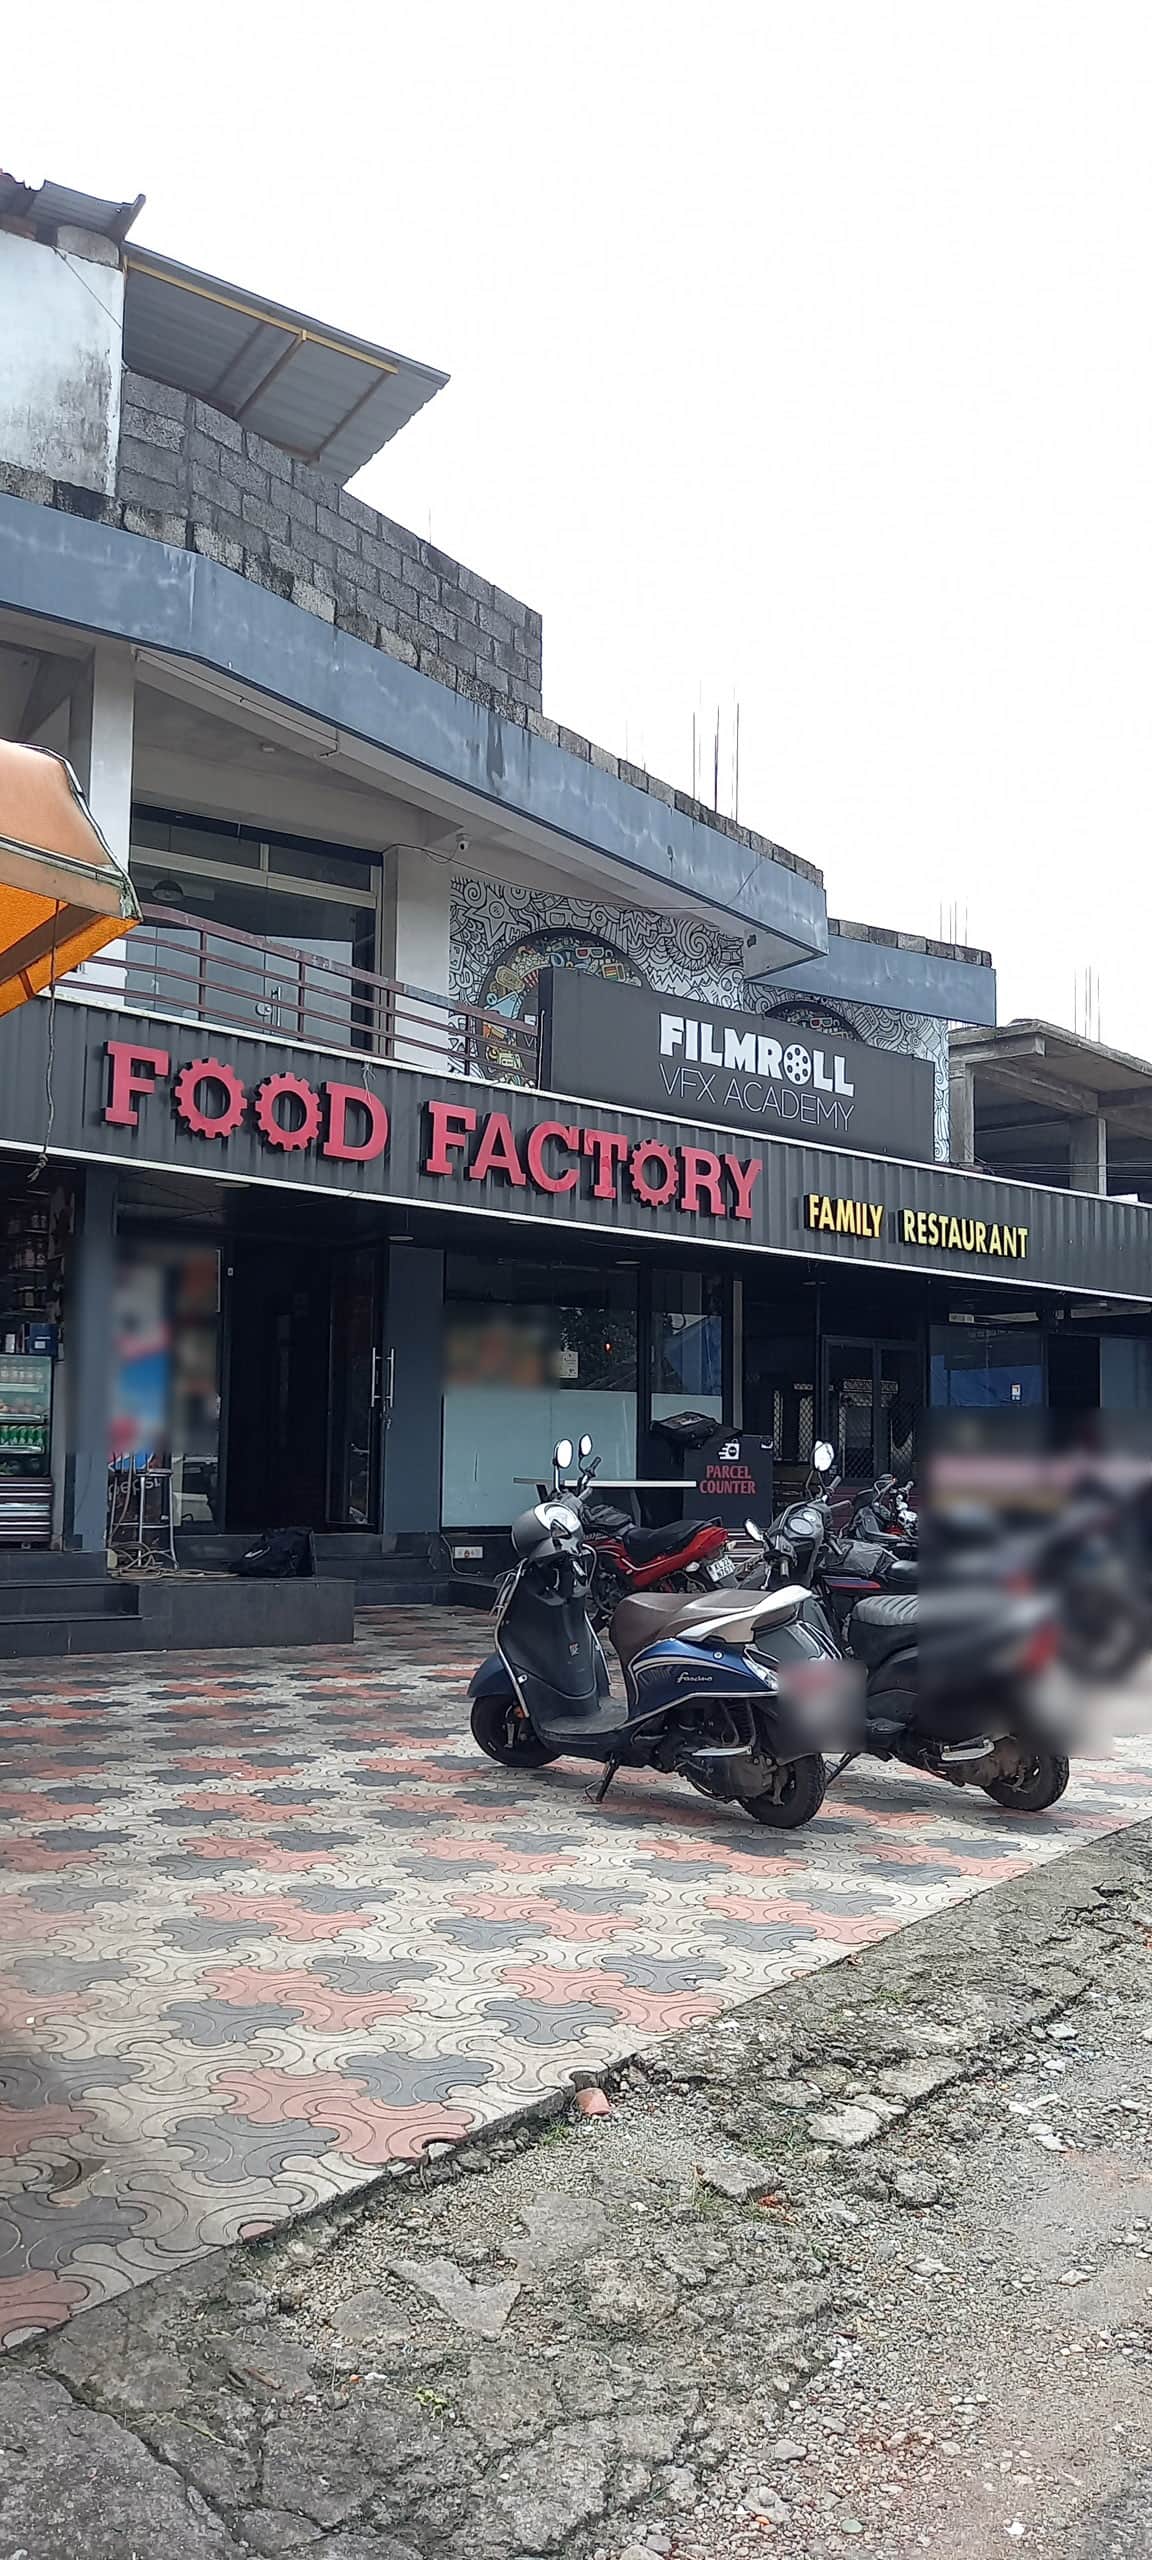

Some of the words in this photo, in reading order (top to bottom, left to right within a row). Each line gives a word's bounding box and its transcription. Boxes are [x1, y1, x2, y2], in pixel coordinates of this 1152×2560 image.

[660, 1013, 854, 1097] FILMROLL
[104, 1040, 389, 1161] FOOD
[426, 1101, 763, 1219] FACTORY
[660, 1063, 716, 1103] VFX
[723, 1078, 854, 1131] ACADEMY
[808, 1193, 883, 1238] FAMILY
[903, 1208, 1028, 1258] RESTAURANT
[700, 1480, 756, 1494] COUNTER
[706, 1465, 752, 1479] PARCEL
